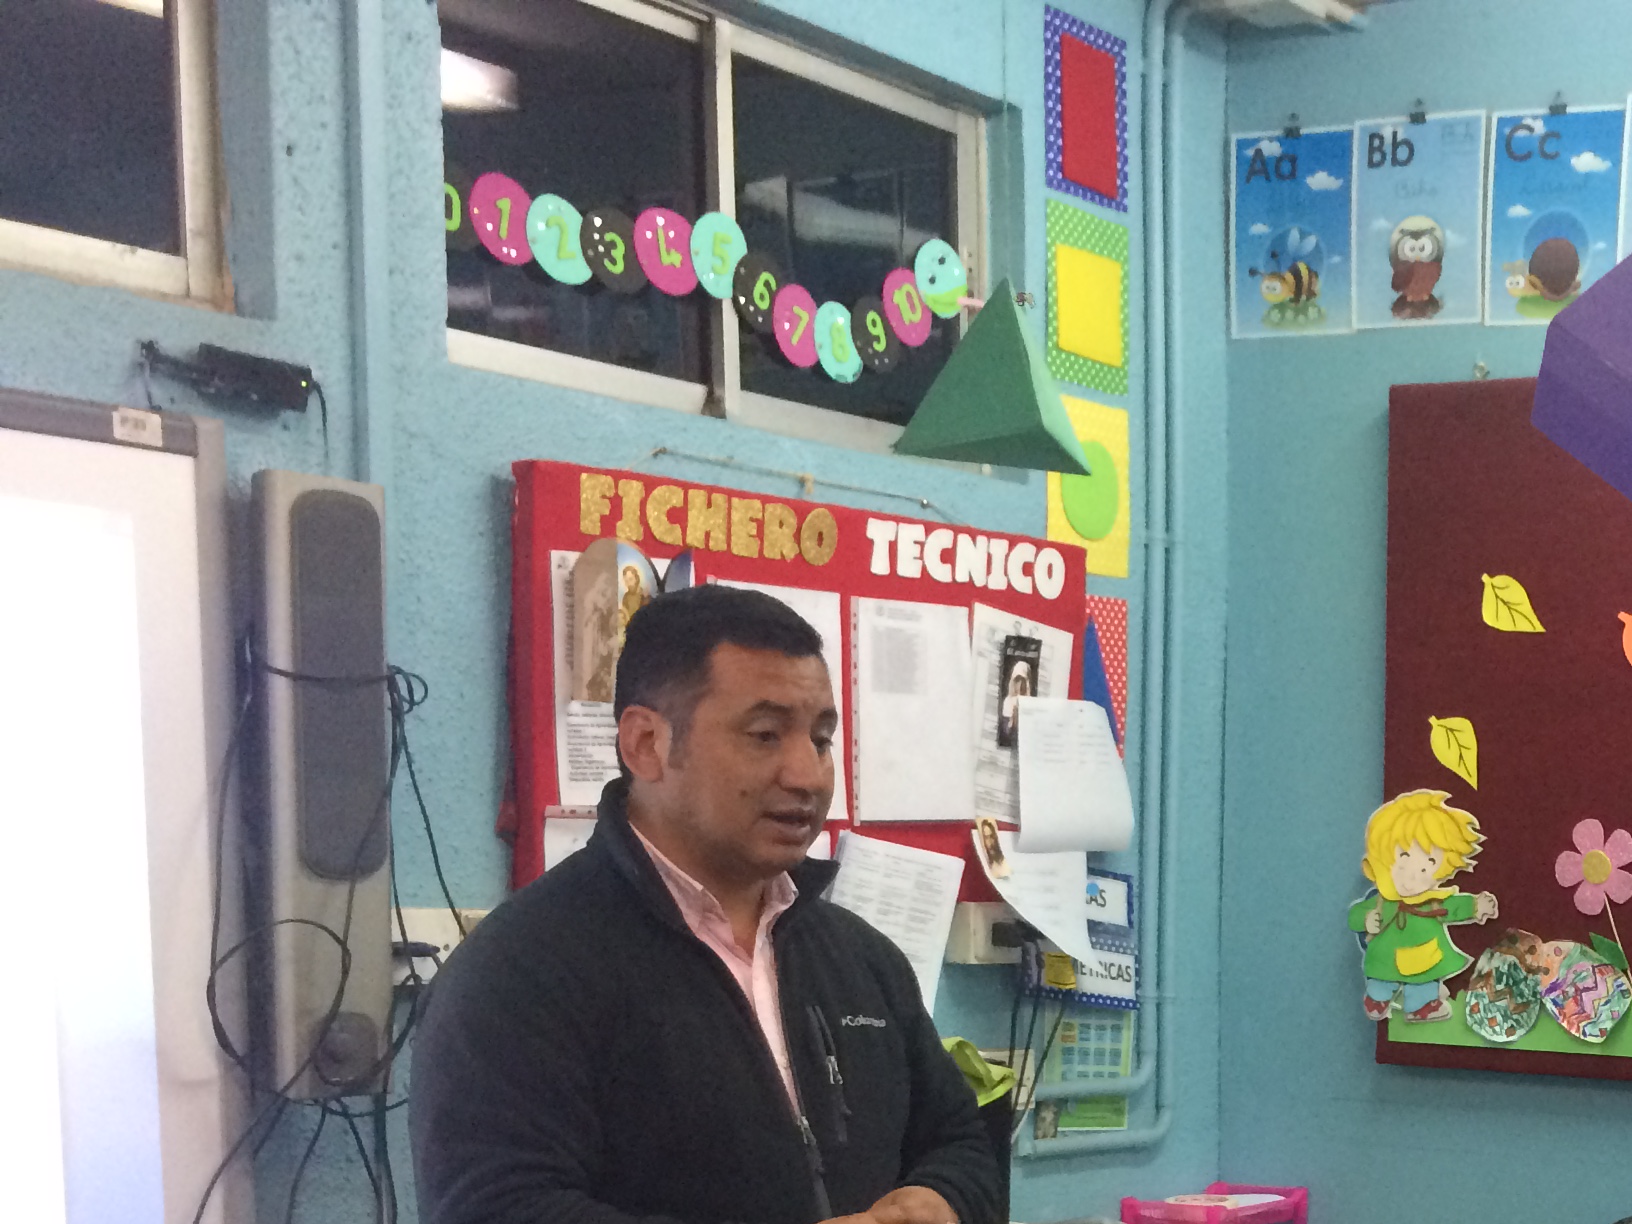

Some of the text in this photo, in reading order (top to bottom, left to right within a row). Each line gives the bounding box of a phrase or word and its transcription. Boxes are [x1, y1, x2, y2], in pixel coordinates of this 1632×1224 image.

[1367, 130, 1415, 168] Bb
[1505, 124, 1562, 162] Cc
[1246, 147, 1298, 183] Aa
[496, 197, 511, 240] 1
[546, 215, 577, 261] 2
[603, 231, 626, 275] 3
[656, 225, 683, 269] 4
[711, 231, 732, 276] 5
[753, 270, 778, 311] 6
[790, 305, 810, 346] 7
[831, 321, 849, 363] 8
[865, 308, 887, 353] 9
[893, 282, 923, 326] 10
[579, 472, 1066, 600] FICHERO TECNICO
